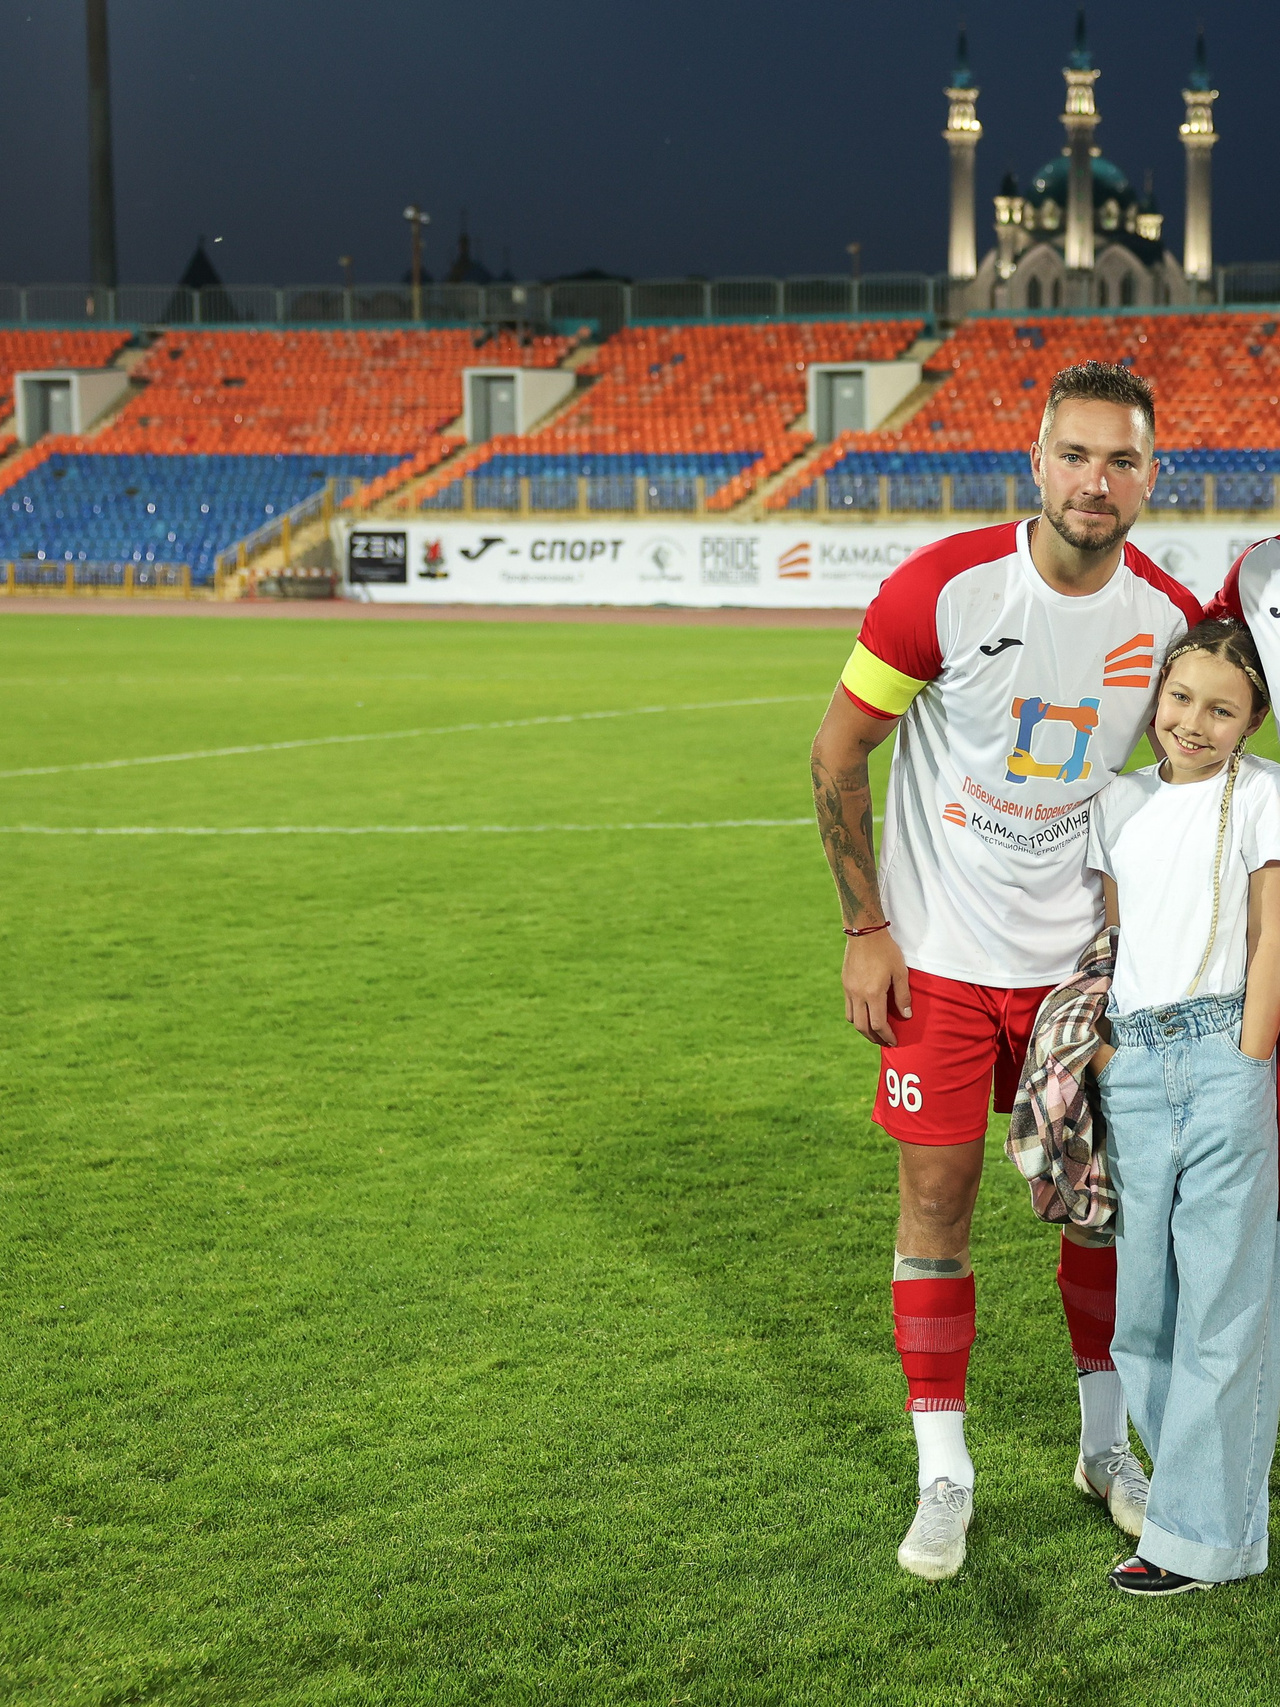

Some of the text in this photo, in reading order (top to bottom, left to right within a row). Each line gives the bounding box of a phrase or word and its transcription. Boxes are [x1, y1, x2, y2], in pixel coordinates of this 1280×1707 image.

[352, 536, 404, 558] ZEN
[530, 539, 626, 562] СПОРТ
[701, 537, 758, 570] PRIDE
[962, 776, 1023, 819] Побеждаем
[1025, 805, 1034, 821] и
[885, 1067, 923, 1113] 96
